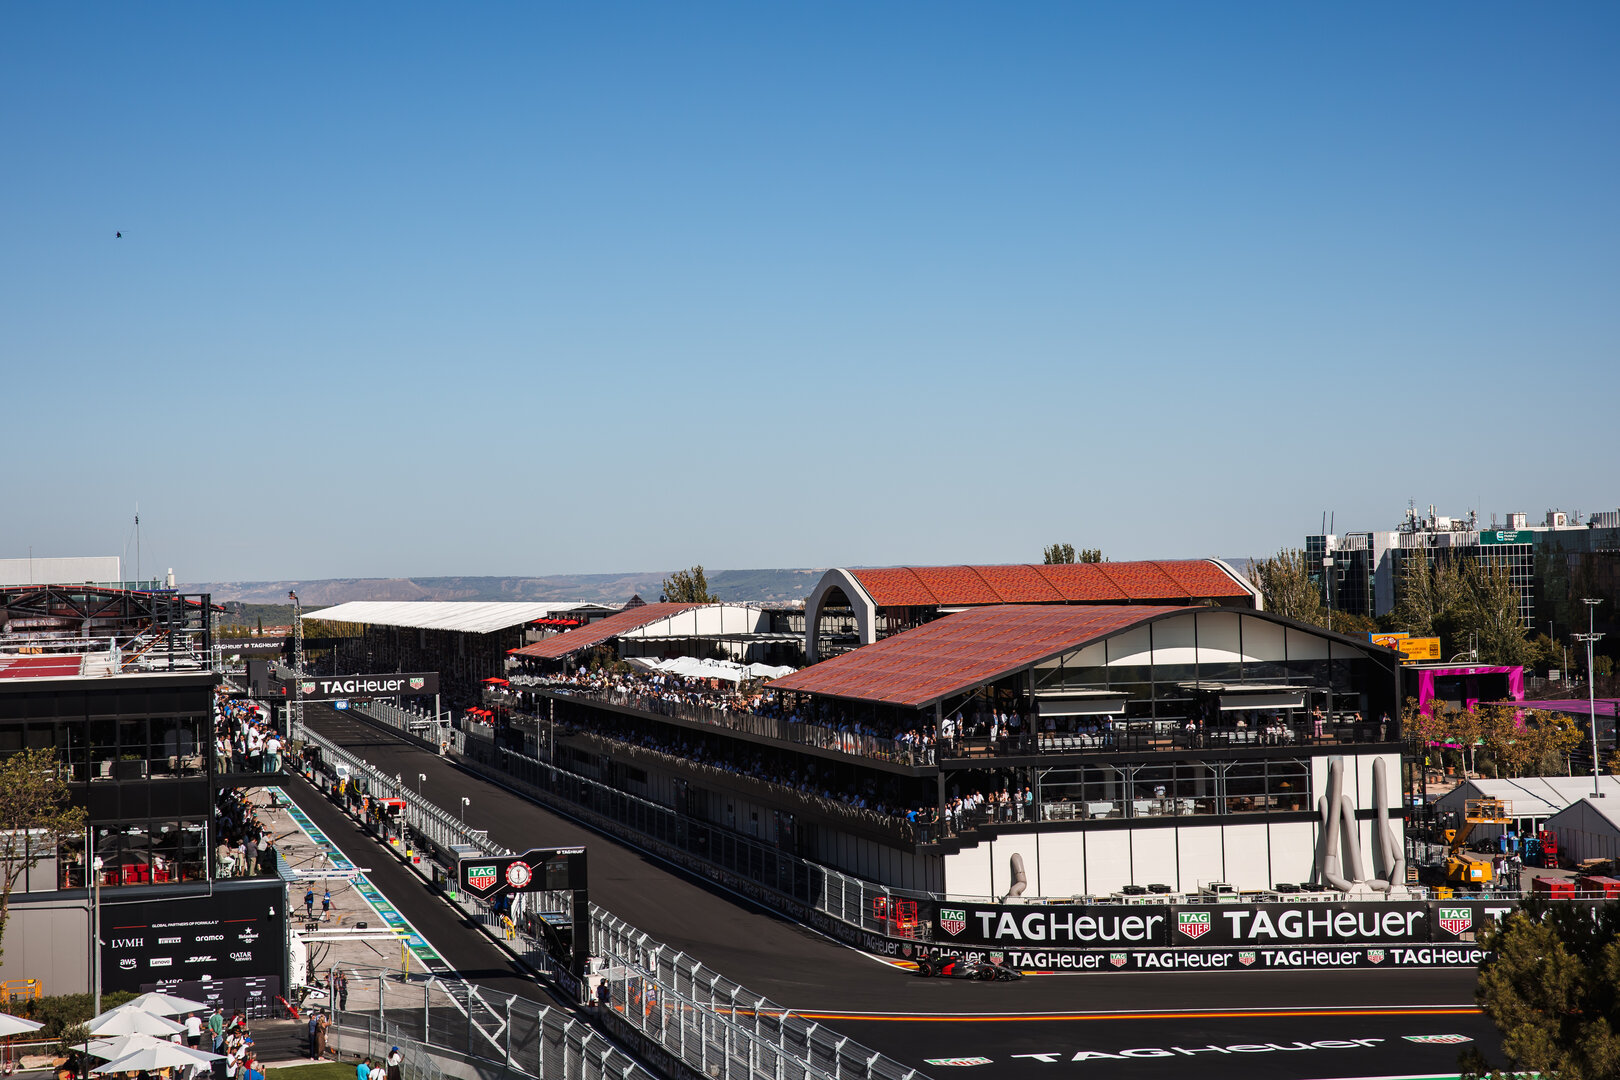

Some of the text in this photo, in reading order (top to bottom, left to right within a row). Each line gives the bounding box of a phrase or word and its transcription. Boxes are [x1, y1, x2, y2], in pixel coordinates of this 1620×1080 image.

[320, 679, 406, 694] TAGHeuer
[471, 868, 494, 876] TAG
[470, 876, 495, 888] HEUER
[942, 910, 964, 920] TAG
[1180, 913, 1208, 922] TAG
[1441, 909, 1469, 918] TAG
[942, 920, 965, 934] HEUER
[975, 911, 1164, 941] TAGHeuer
[1180, 924, 1209, 937] HEUER
[1223, 909, 1425, 939] TAGHeuer
[1441, 920, 1471, 933] HEUER
[111, 938, 144, 948] LVMH
[195, 934, 224, 942] aramco
[230, 951, 252, 959] QATAR
[1008, 952, 1105, 968] TAGHeuer
[1132, 952, 1234, 968] TAGHeuer
[1261, 950, 1362, 966] TAGHeuer
[1390, 948, 1492, 964] TAGHeuer
[1010, 1038, 1386, 1063] TAGHeuer
